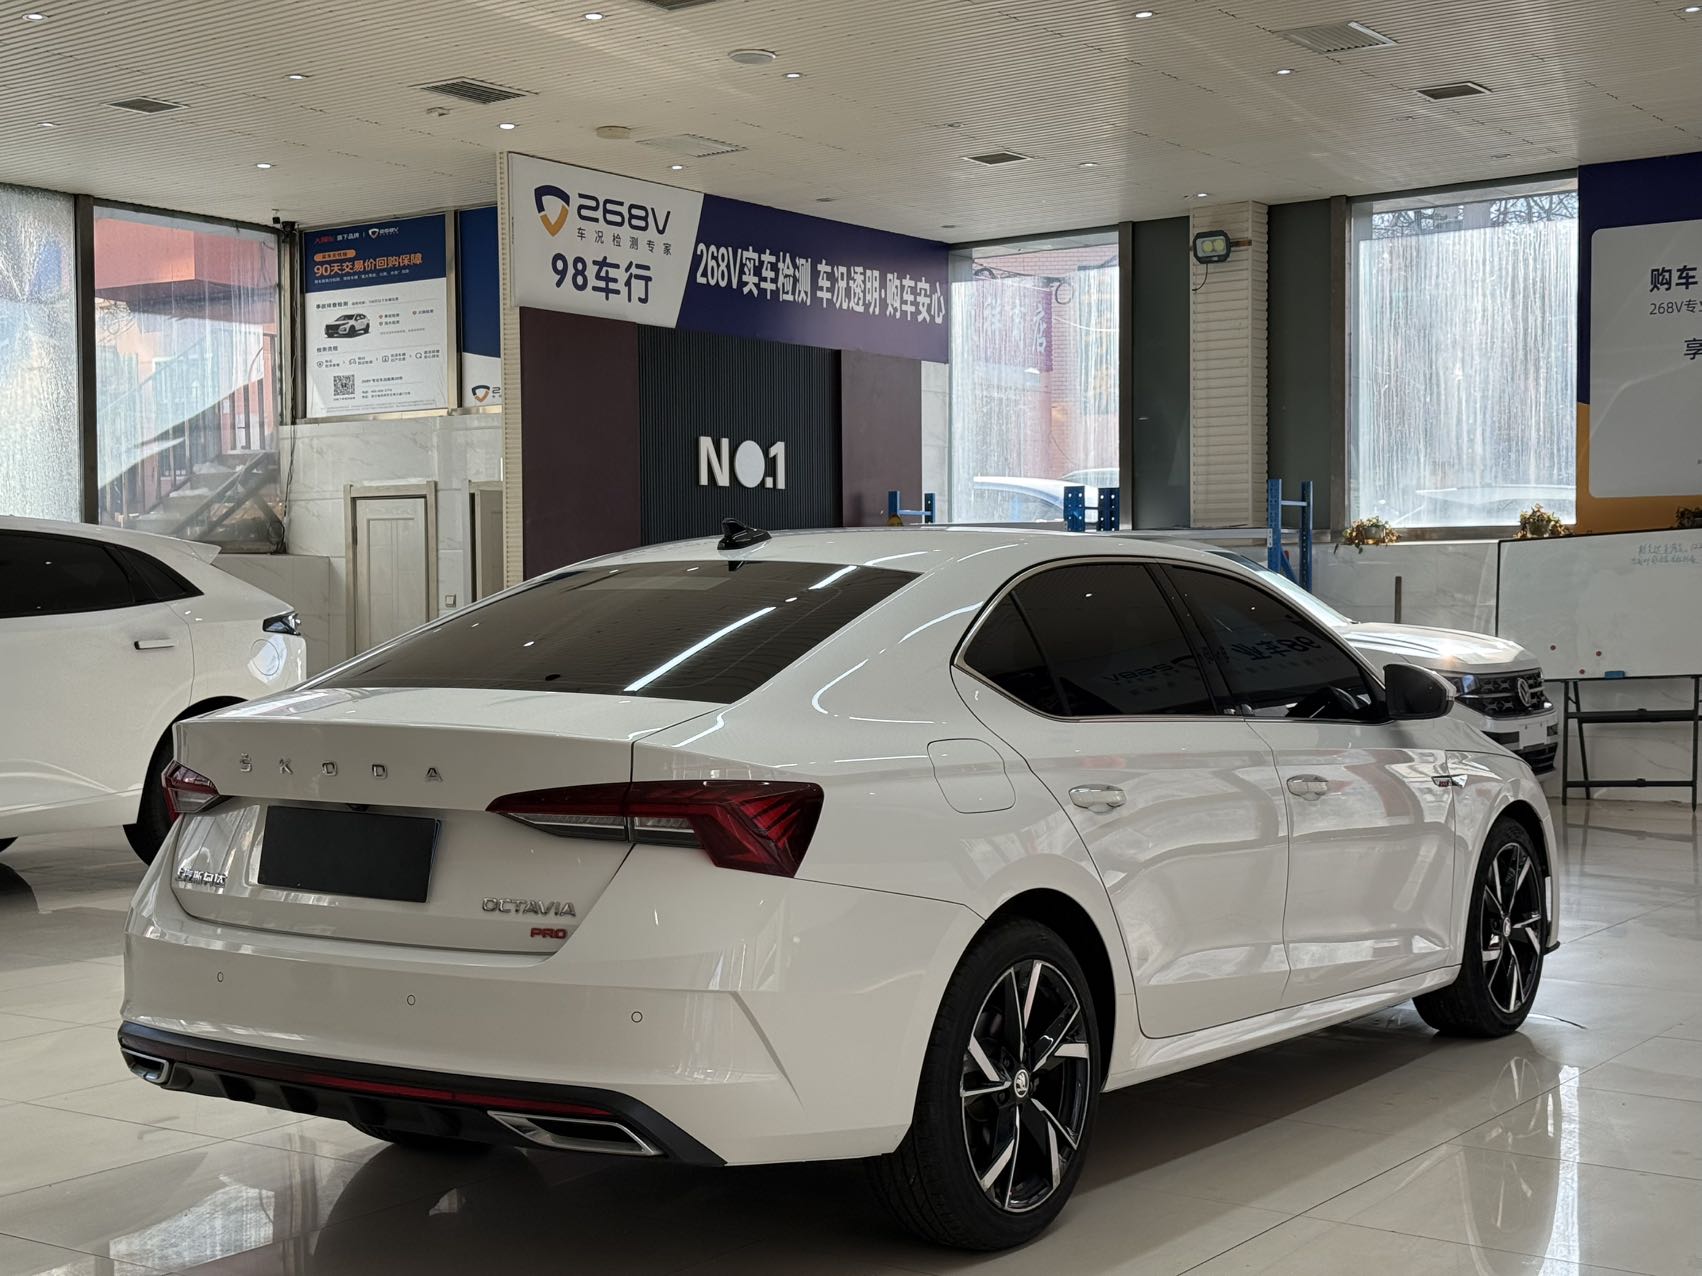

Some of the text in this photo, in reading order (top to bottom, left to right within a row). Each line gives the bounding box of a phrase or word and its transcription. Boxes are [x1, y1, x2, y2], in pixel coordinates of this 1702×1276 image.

[576, 192, 671, 235] 268V
[576, 226, 672, 256] 车况检测专家
[314, 253, 423, 277] 90天交易价回购保障
[551, 252, 653, 304] 98车行
[696, 243, 811, 306] 268V实车检测
[1649, 265, 1698, 293] 购车
[699, 436, 786, 489] NO.1
[481, 896, 577, 918] OCTAVIA
[530, 927, 568, 940] PRO
